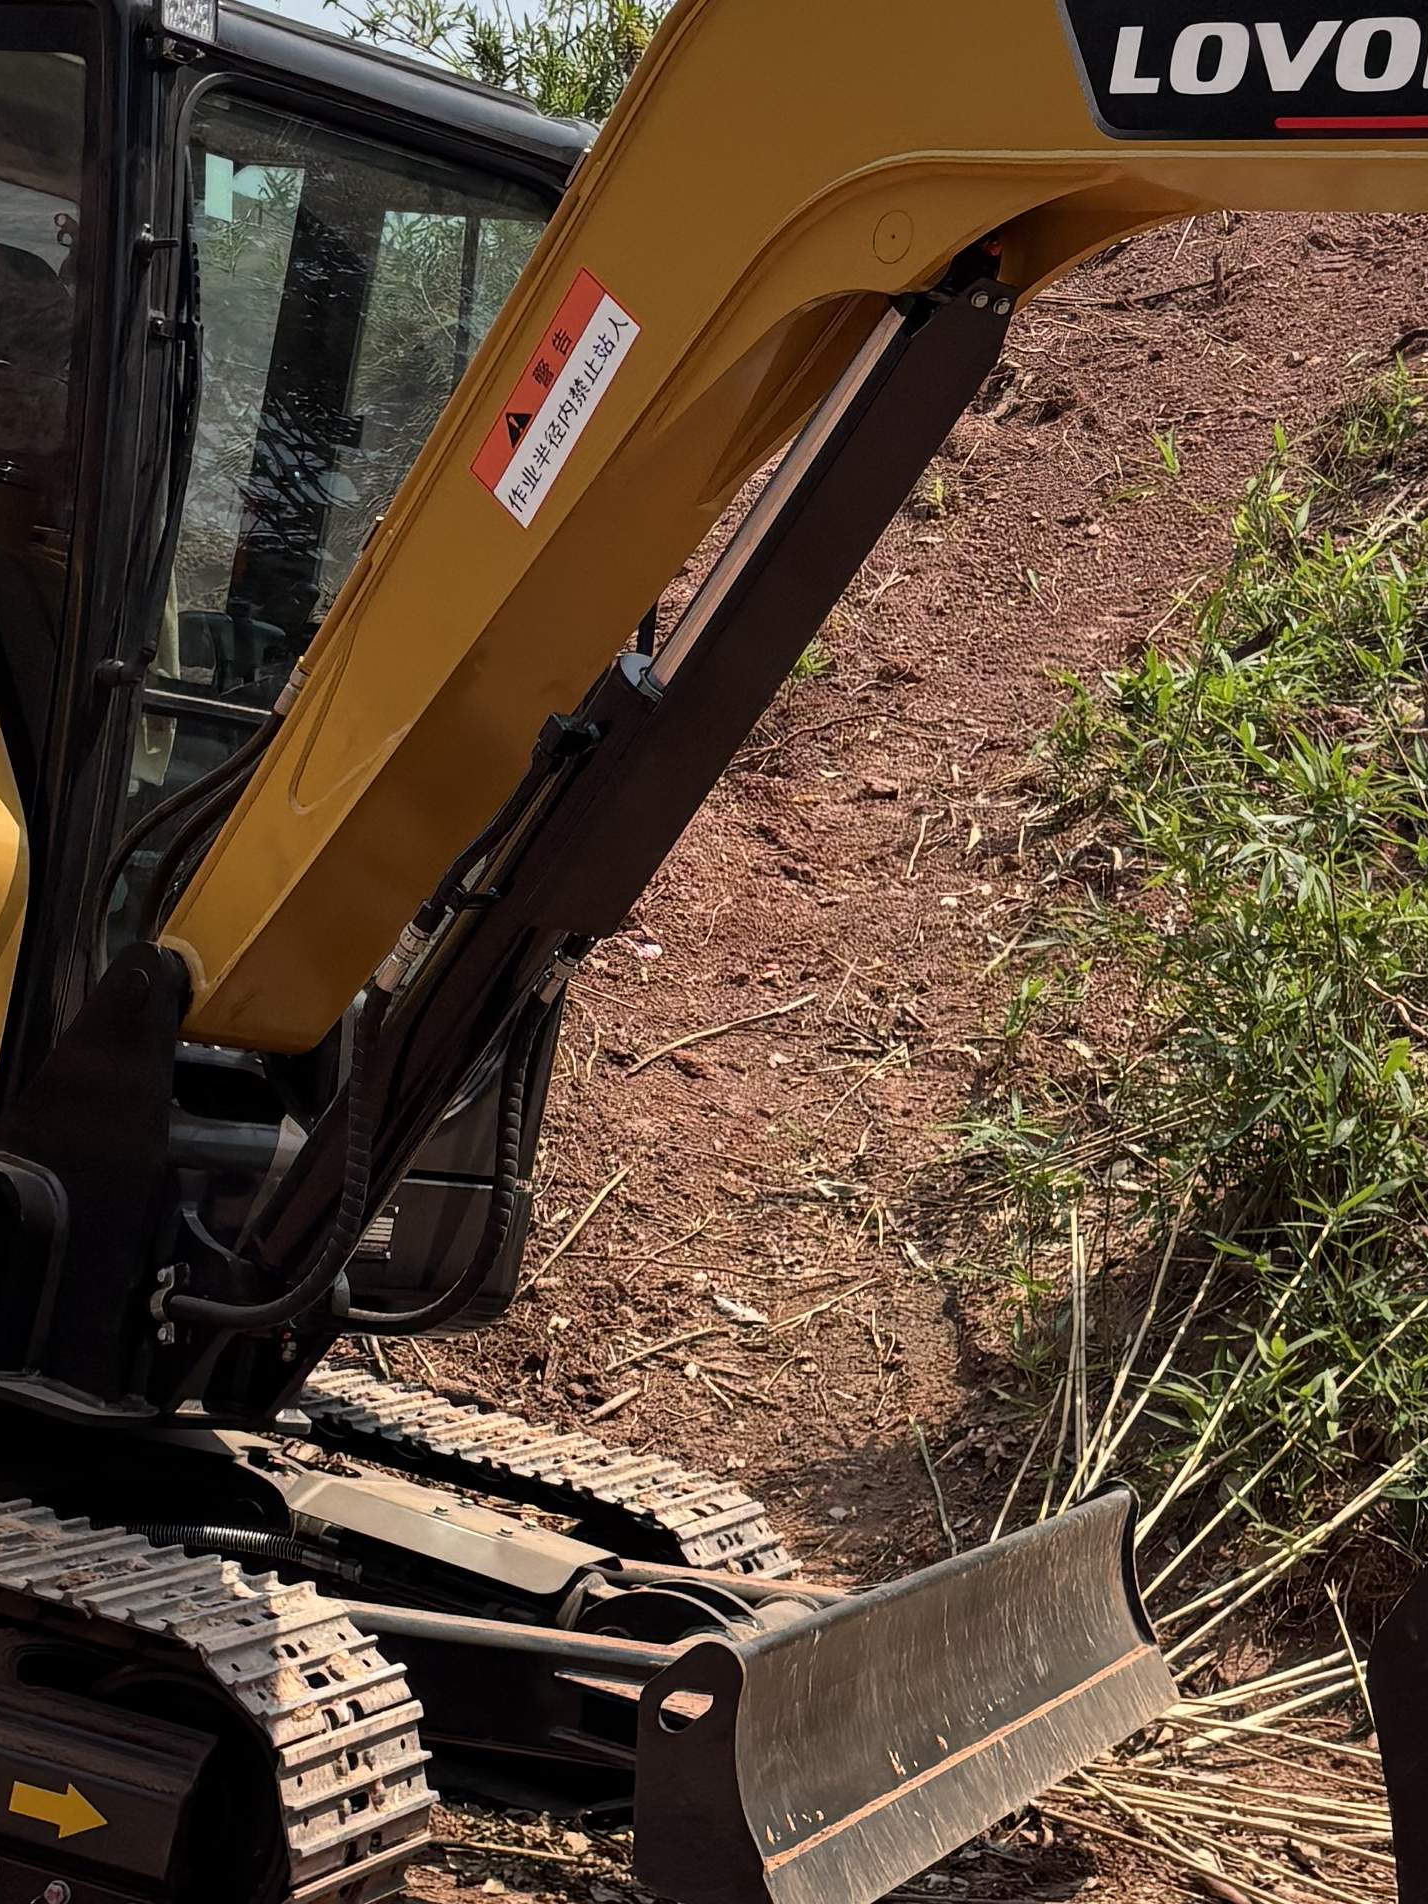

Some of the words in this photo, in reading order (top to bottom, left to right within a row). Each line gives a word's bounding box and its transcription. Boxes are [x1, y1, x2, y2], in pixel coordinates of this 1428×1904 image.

[508, 316, 629, 512] 作业半径内禁止站人
[532, 328, 573, 388] 警告
